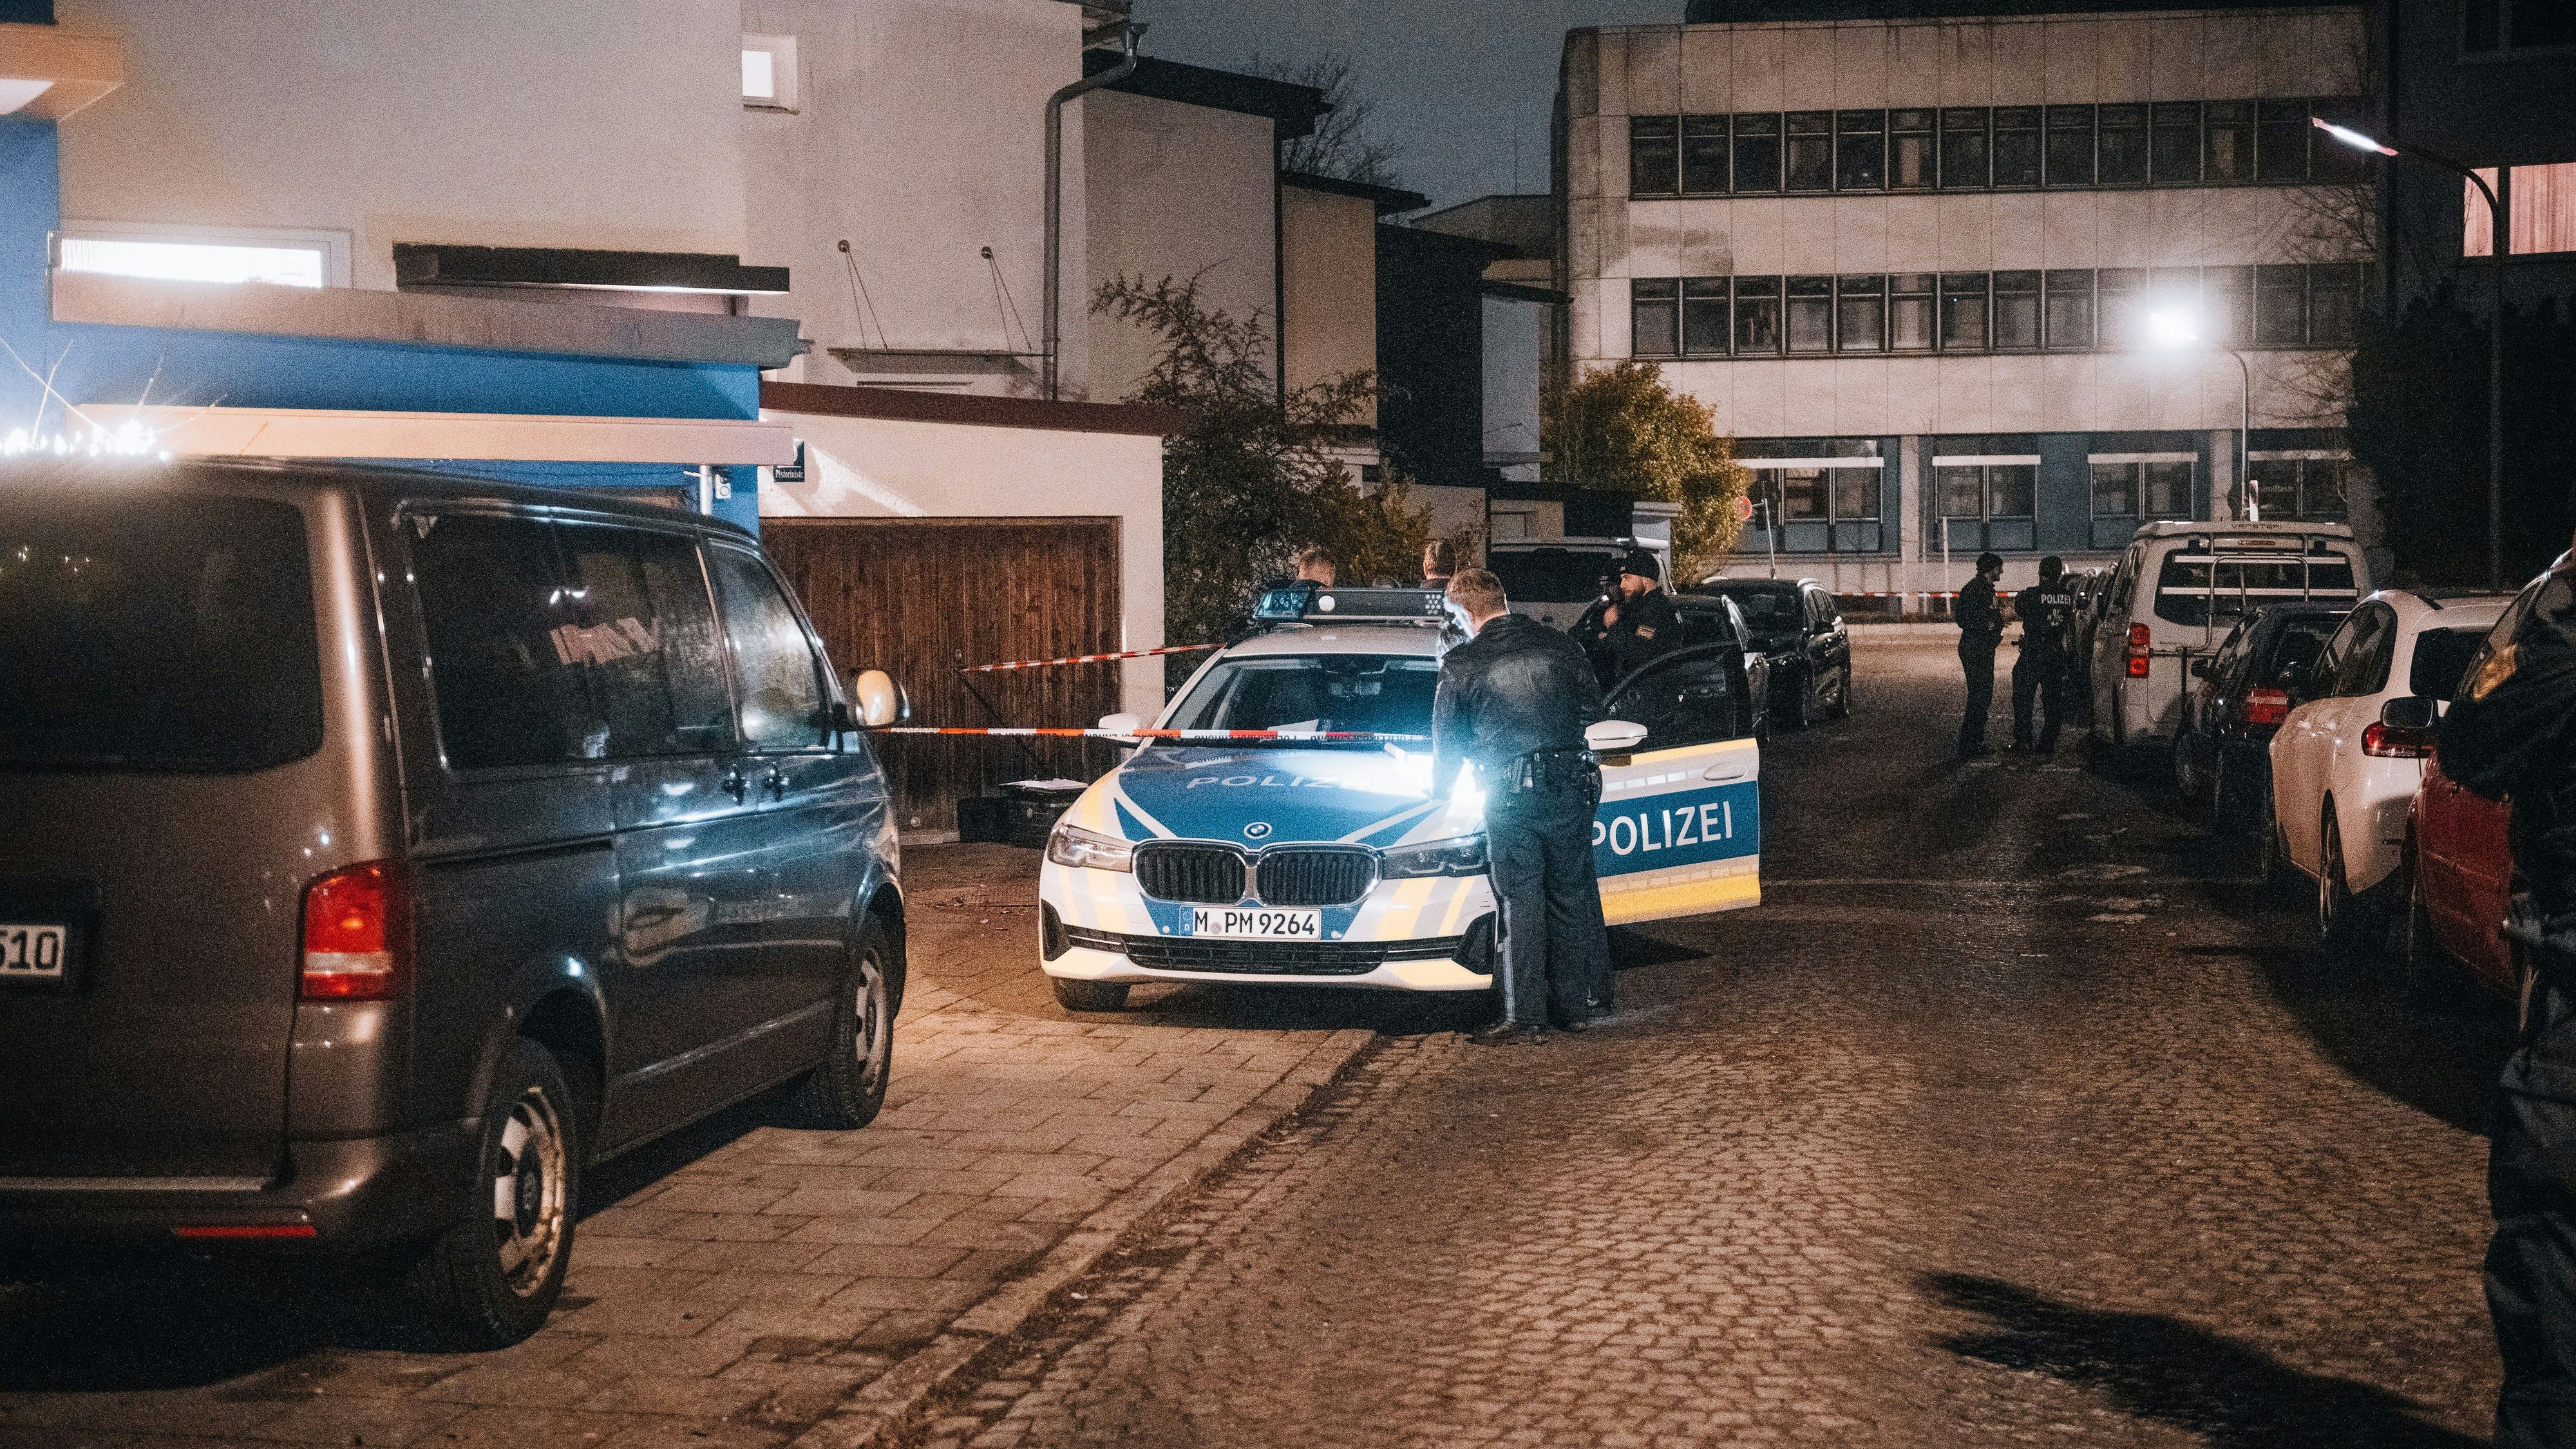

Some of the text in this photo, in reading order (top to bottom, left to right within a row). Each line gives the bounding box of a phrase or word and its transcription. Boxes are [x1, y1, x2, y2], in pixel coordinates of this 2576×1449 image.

[2041, 594, 2071, 604] POLIZEI
[1194, 911, 1314, 935] M PM 9264
